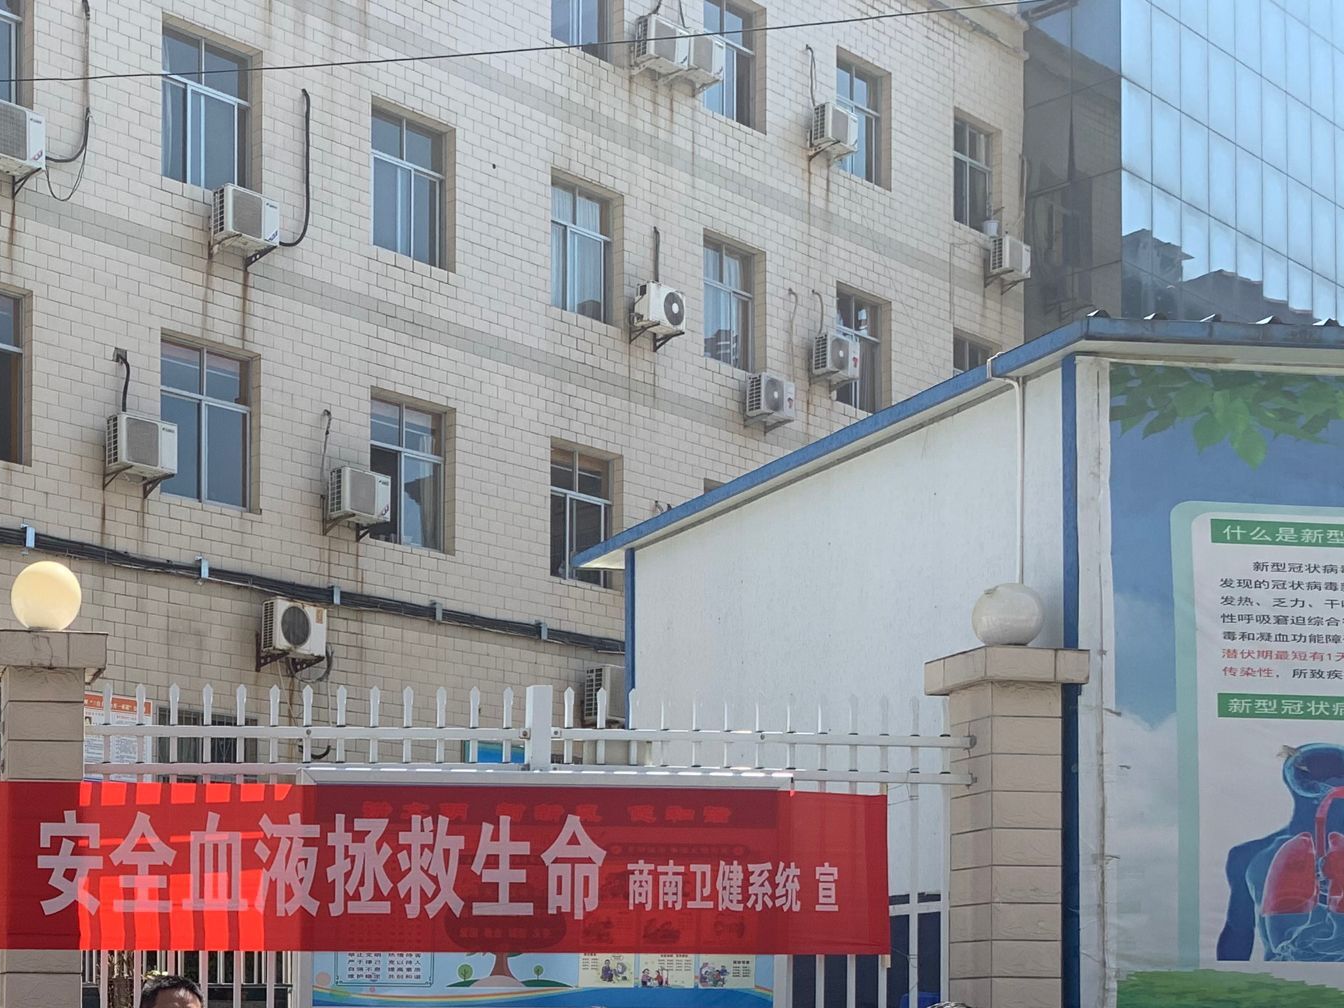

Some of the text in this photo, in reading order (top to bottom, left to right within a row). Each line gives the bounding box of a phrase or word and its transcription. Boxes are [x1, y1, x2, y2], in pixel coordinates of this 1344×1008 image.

[1223, 525, 1344, 545] 什么是新型
[1253, 561, 1344, 575] 新型冠状病
[1219, 578, 1344, 592] 发现的冠状病毒
[1220, 596, 1344, 609] 发热、乏力、干
[1221, 613, 1344, 627] 性呼吸窘迫综合
[1223, 631, 1344, 645] 毒和凝血功能障
[37, 810, 607, 920] 安全血液拯救生命
[627, 859, 801, 912] 商南卫健系统
[815, 862, 839, 912] 宣
